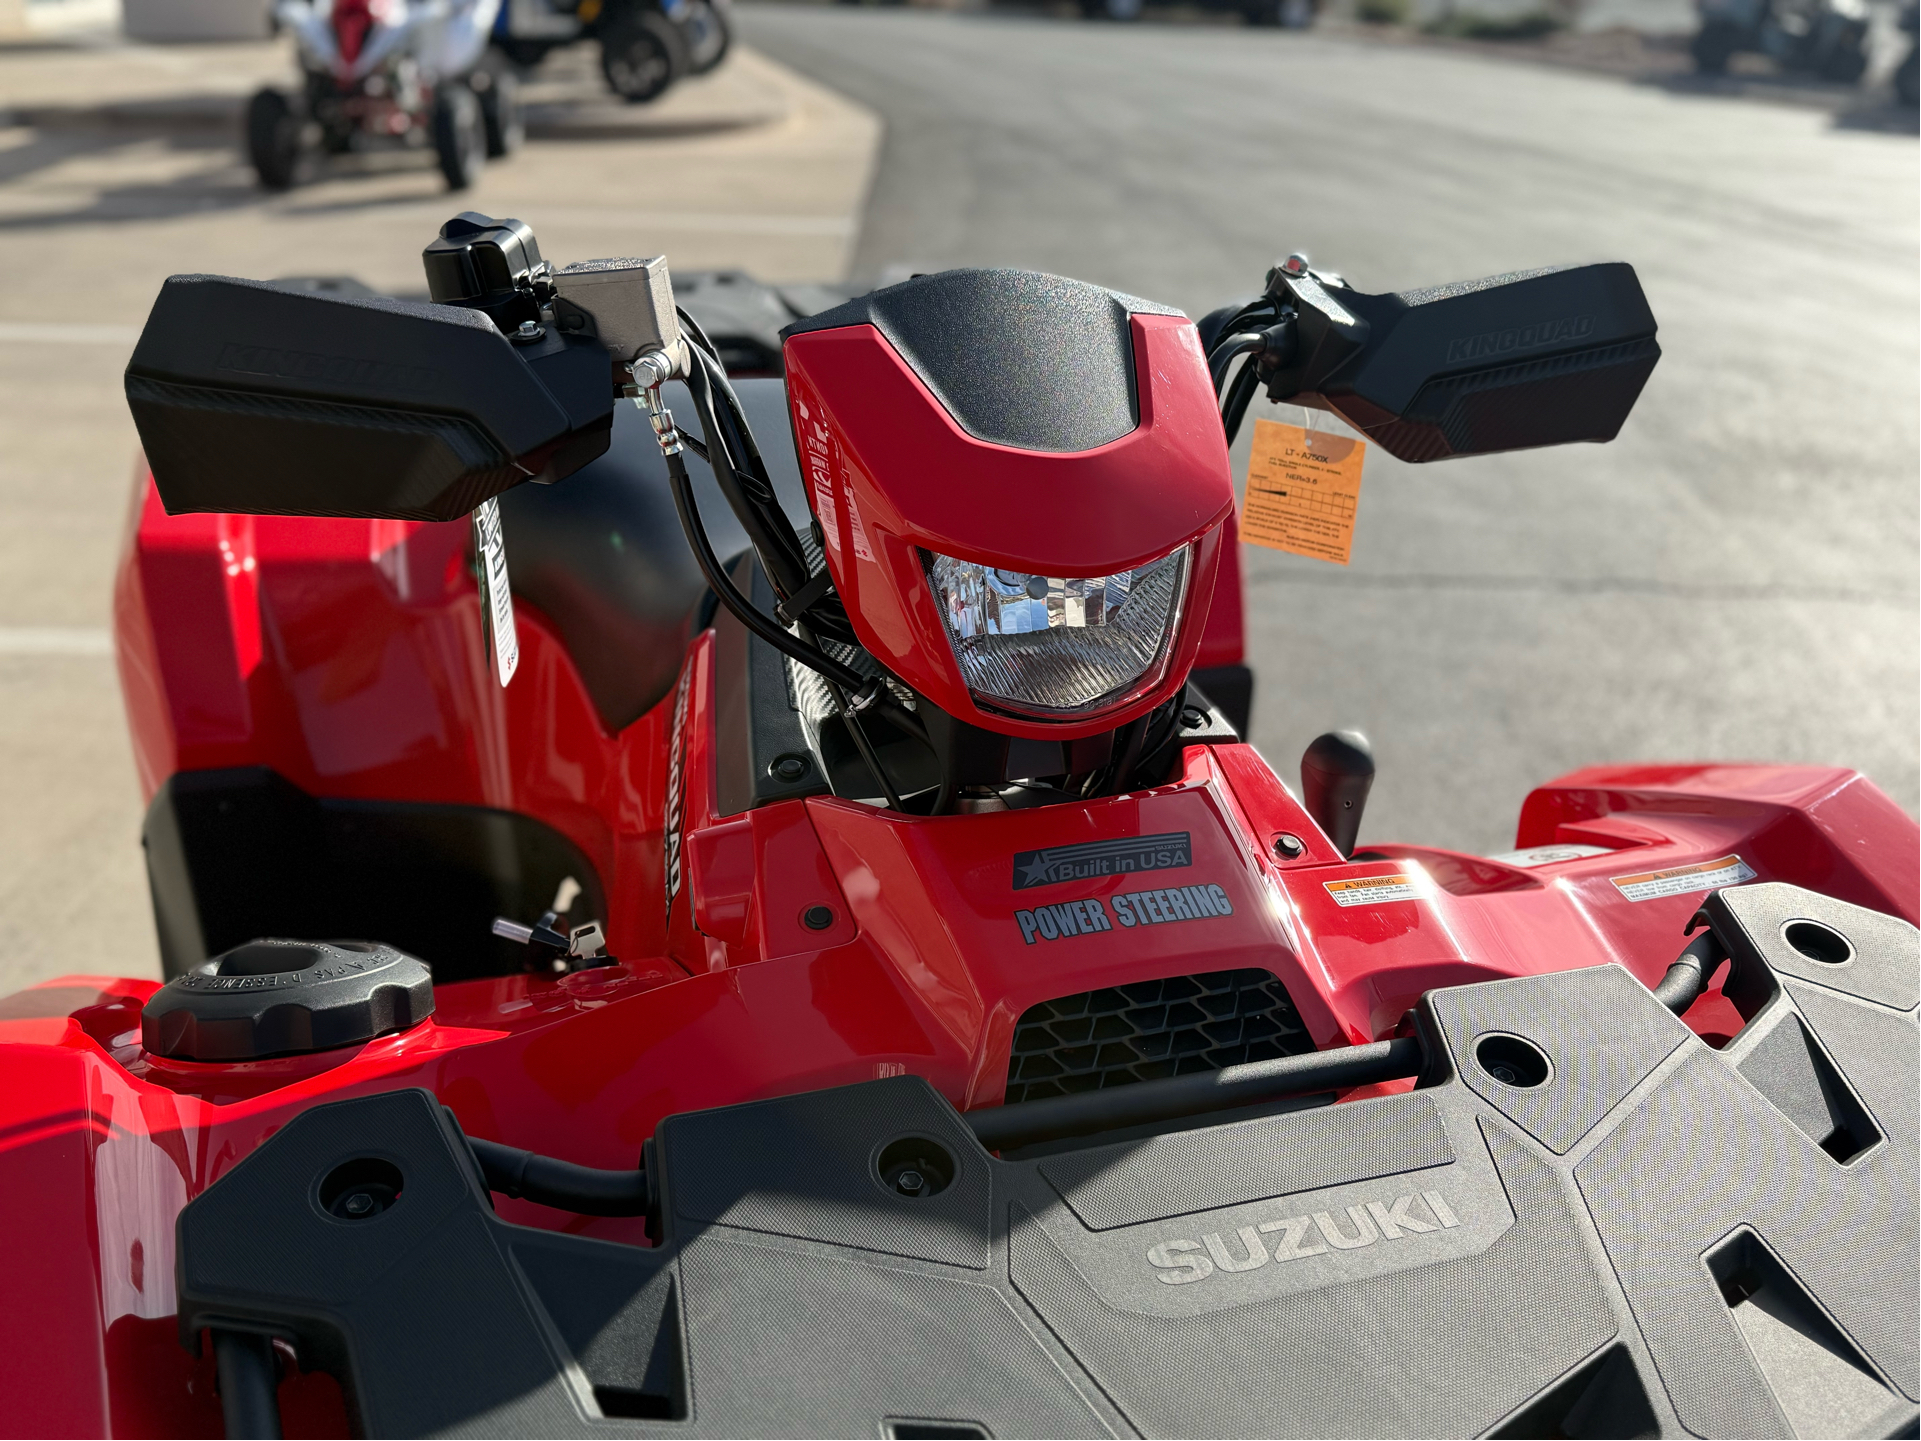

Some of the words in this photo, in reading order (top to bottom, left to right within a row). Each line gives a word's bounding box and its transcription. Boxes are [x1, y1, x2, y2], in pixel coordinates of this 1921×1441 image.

[1446, 314, 1596, 364] KINGQUAD
[1285, 448, 1296, 456] LT
[1155, 843, 1187, 851] SUZUKI
[1059, 859, 1110, 881] Built
[1115, 856, 1135, 872] in
[1140, 850, 1188, 869] USA
[1663, 866, 1702, 878] WARNING
[1353, 879, 1395, 888] WARNING
[1014, 898, 1113, 945] POWER
[1110, 883, 1234, 928] STEERING
[1146, 1189, 1461, 1285] SUZUKI
